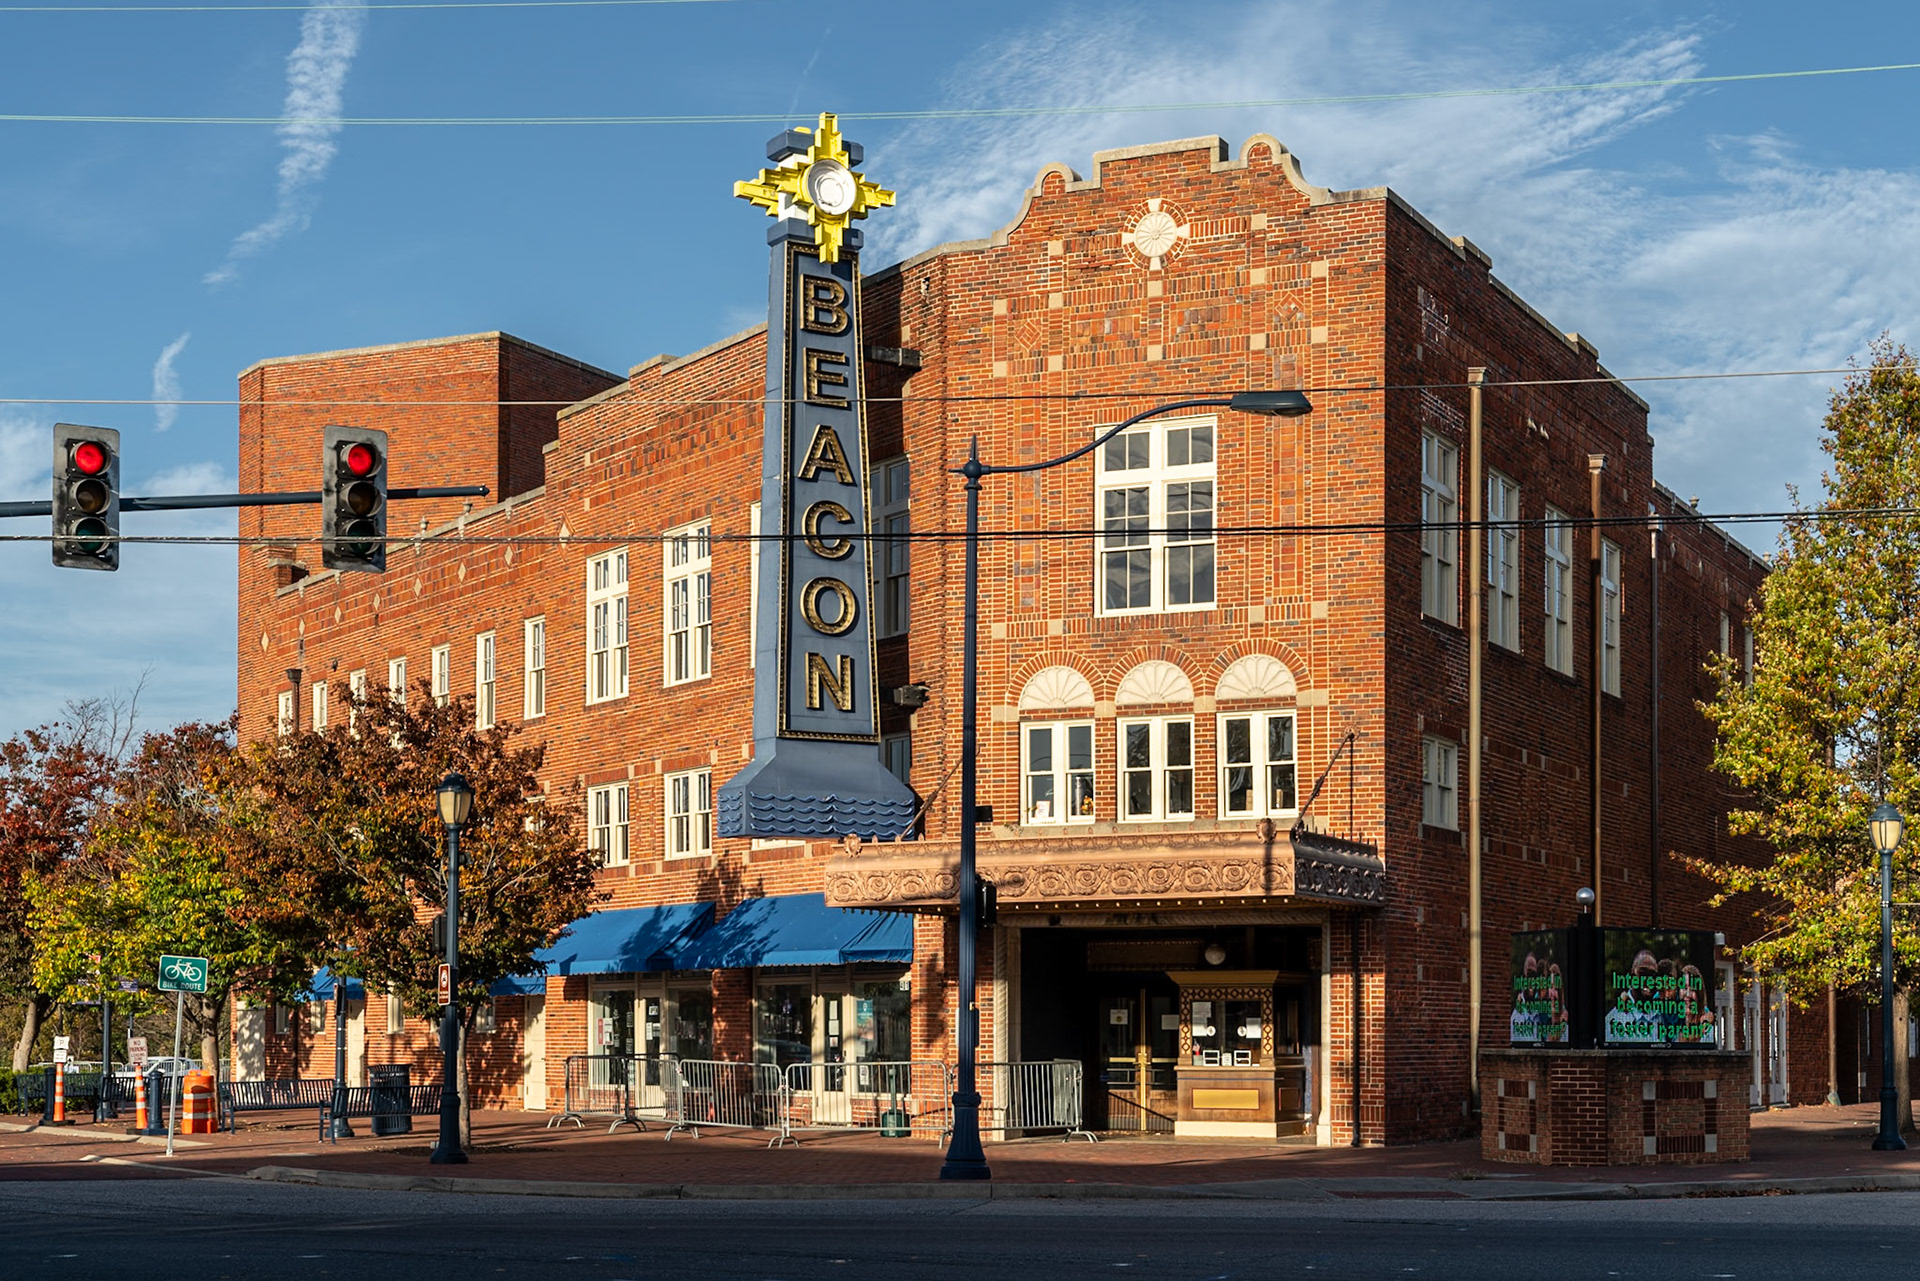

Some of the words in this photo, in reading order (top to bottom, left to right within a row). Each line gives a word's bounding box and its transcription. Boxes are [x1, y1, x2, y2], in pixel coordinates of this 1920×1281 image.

[798, 273, 857, 711] BEACON
[162, 980, 178, 988] BIKE
[180, 982, 202, 990] ROUTE
[1513, 974, 1553, 991] Interested
[1554, 974, 1562, 989] in
[1612, 971, 1686, 990] Interested
[1690, 973, 1702, 990] in
[1516, 999, 1552, 1017] becoming
[1617, 997, 1686, 1018] becoming
[1690, 1000, 1698, 1014] a
[1610, 1018, 1655, 1037] foster
[1658, 1020, 1712, 1041] parent?
